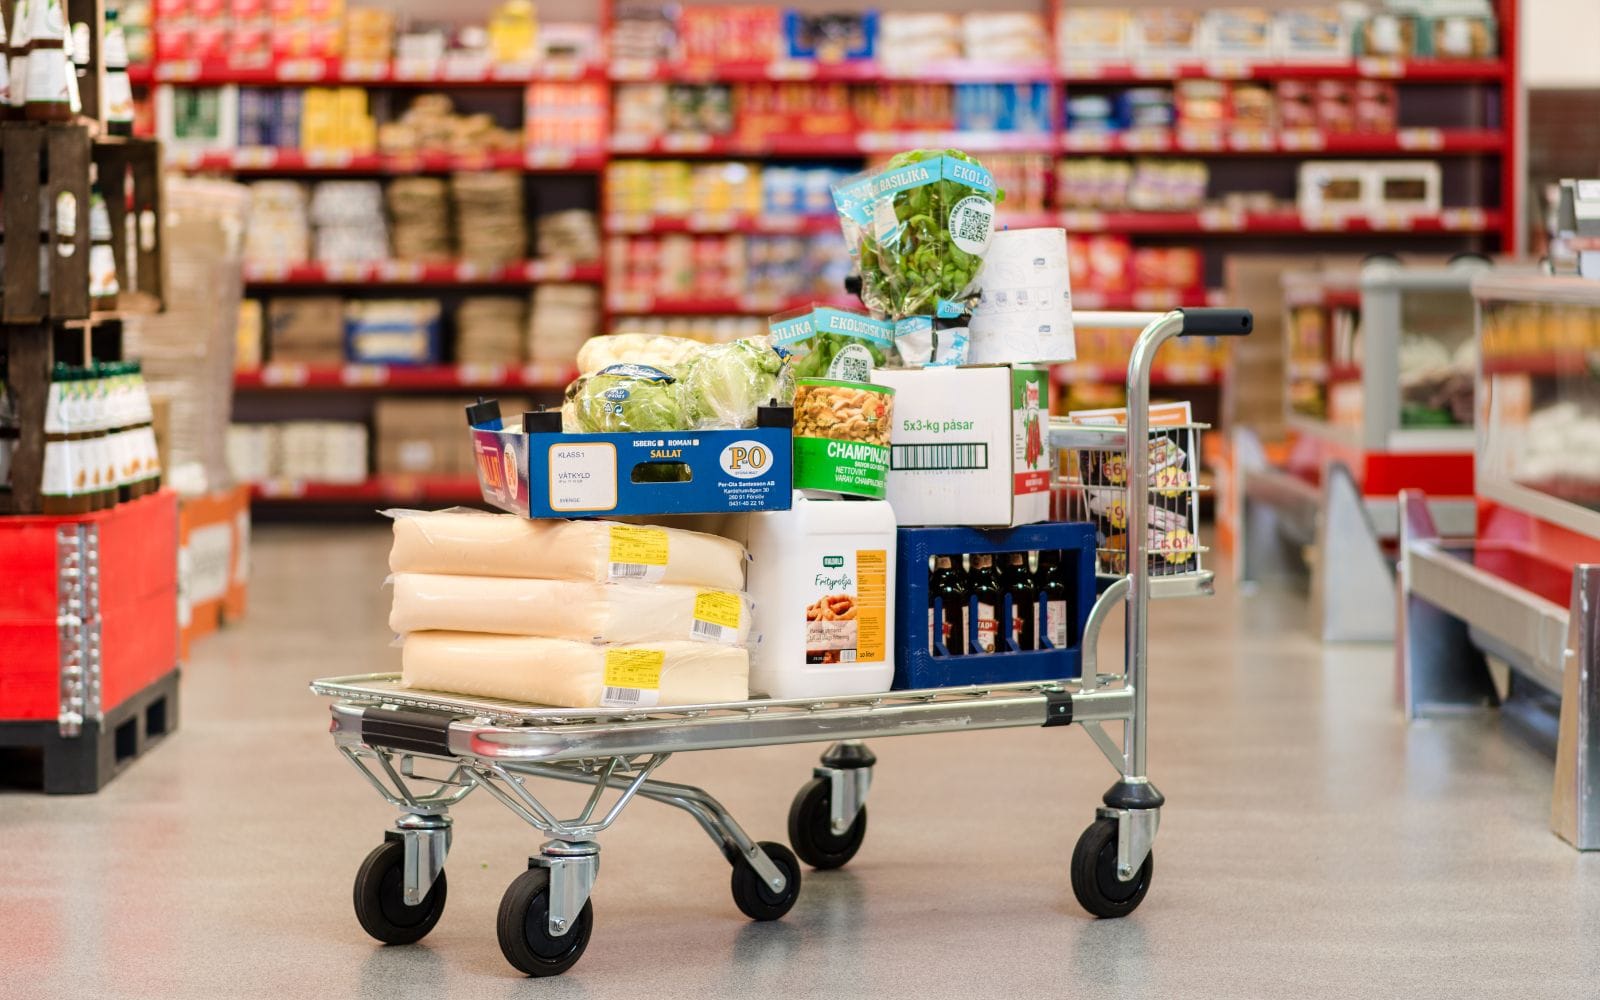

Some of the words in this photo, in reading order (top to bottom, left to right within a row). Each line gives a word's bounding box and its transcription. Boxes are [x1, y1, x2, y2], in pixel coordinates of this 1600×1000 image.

[879, 167, 929, 191] BASILIKA
[903, 420, 940, 433] 5x3-kg
[943, 419, 974, 433] påsar
[650, 449, 682, 459] SALLAT
